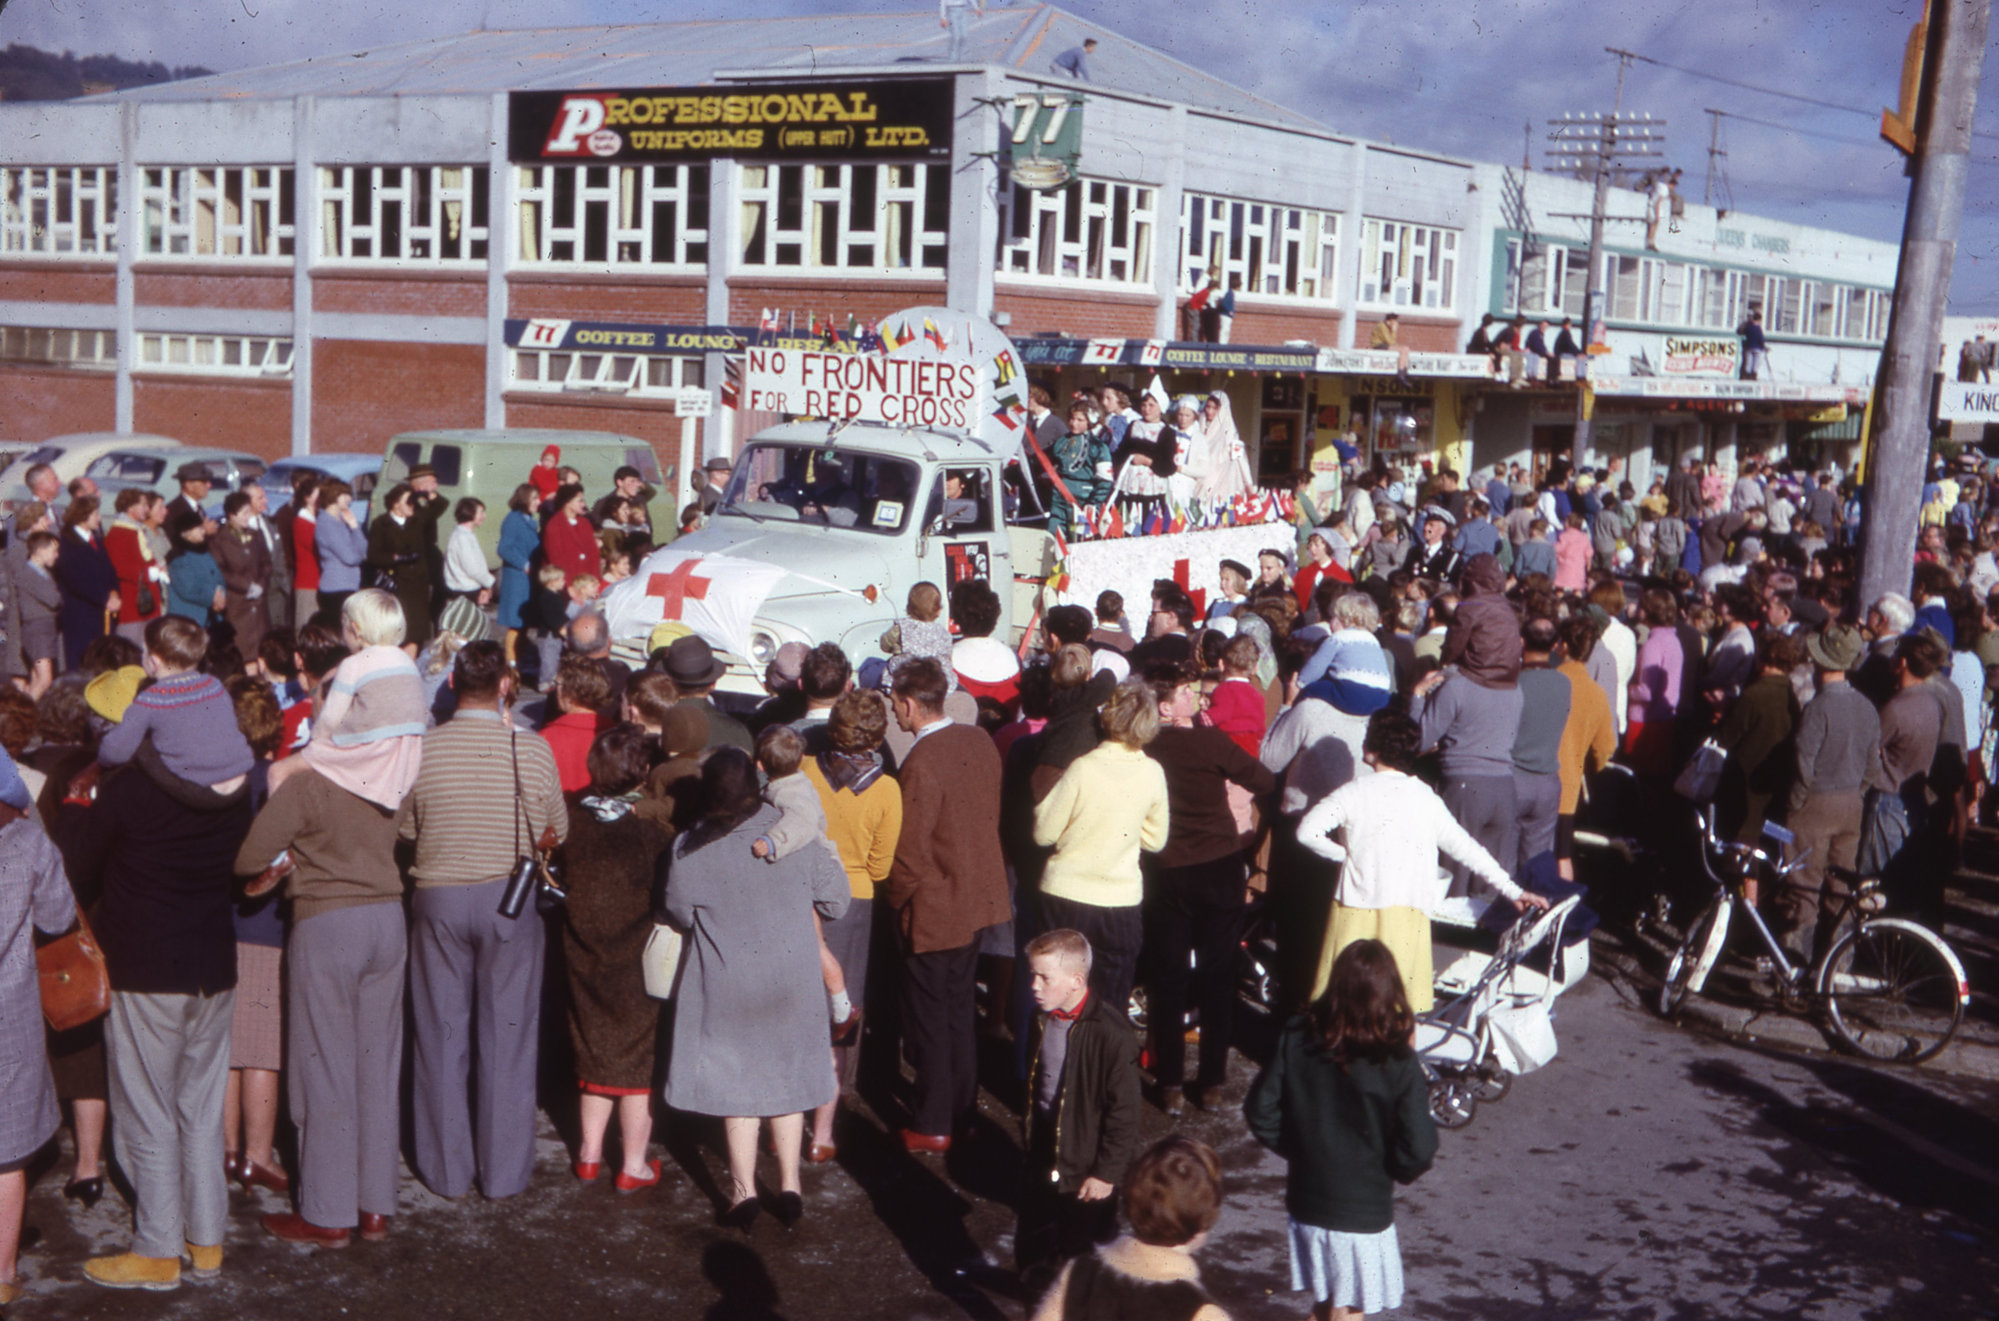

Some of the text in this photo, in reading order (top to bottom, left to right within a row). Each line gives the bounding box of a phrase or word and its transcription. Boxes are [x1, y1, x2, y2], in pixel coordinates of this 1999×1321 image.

[548, 92, 877, 152] PROFESSIONAL
[1011, 93, 1071, 144] 77
[630, 129, 764, 149] UNIFORMS
[866, 127, 930, 147] LTD.
[576, 330, 655, 346] COFFEE
[1665, 337, 1736, 357] SIMPSONS
[750, 350, 785, 375] NO
[1166, 349, 1206, 363] COFFEE
[1210, 352, 1248, 365] LOUNGE
[1255, 353, 1315, 366] RESTAURANT
[802, 353, 975, 399] FRONTIERS
[751, 390, 967, 427] FOR RED CROSS
